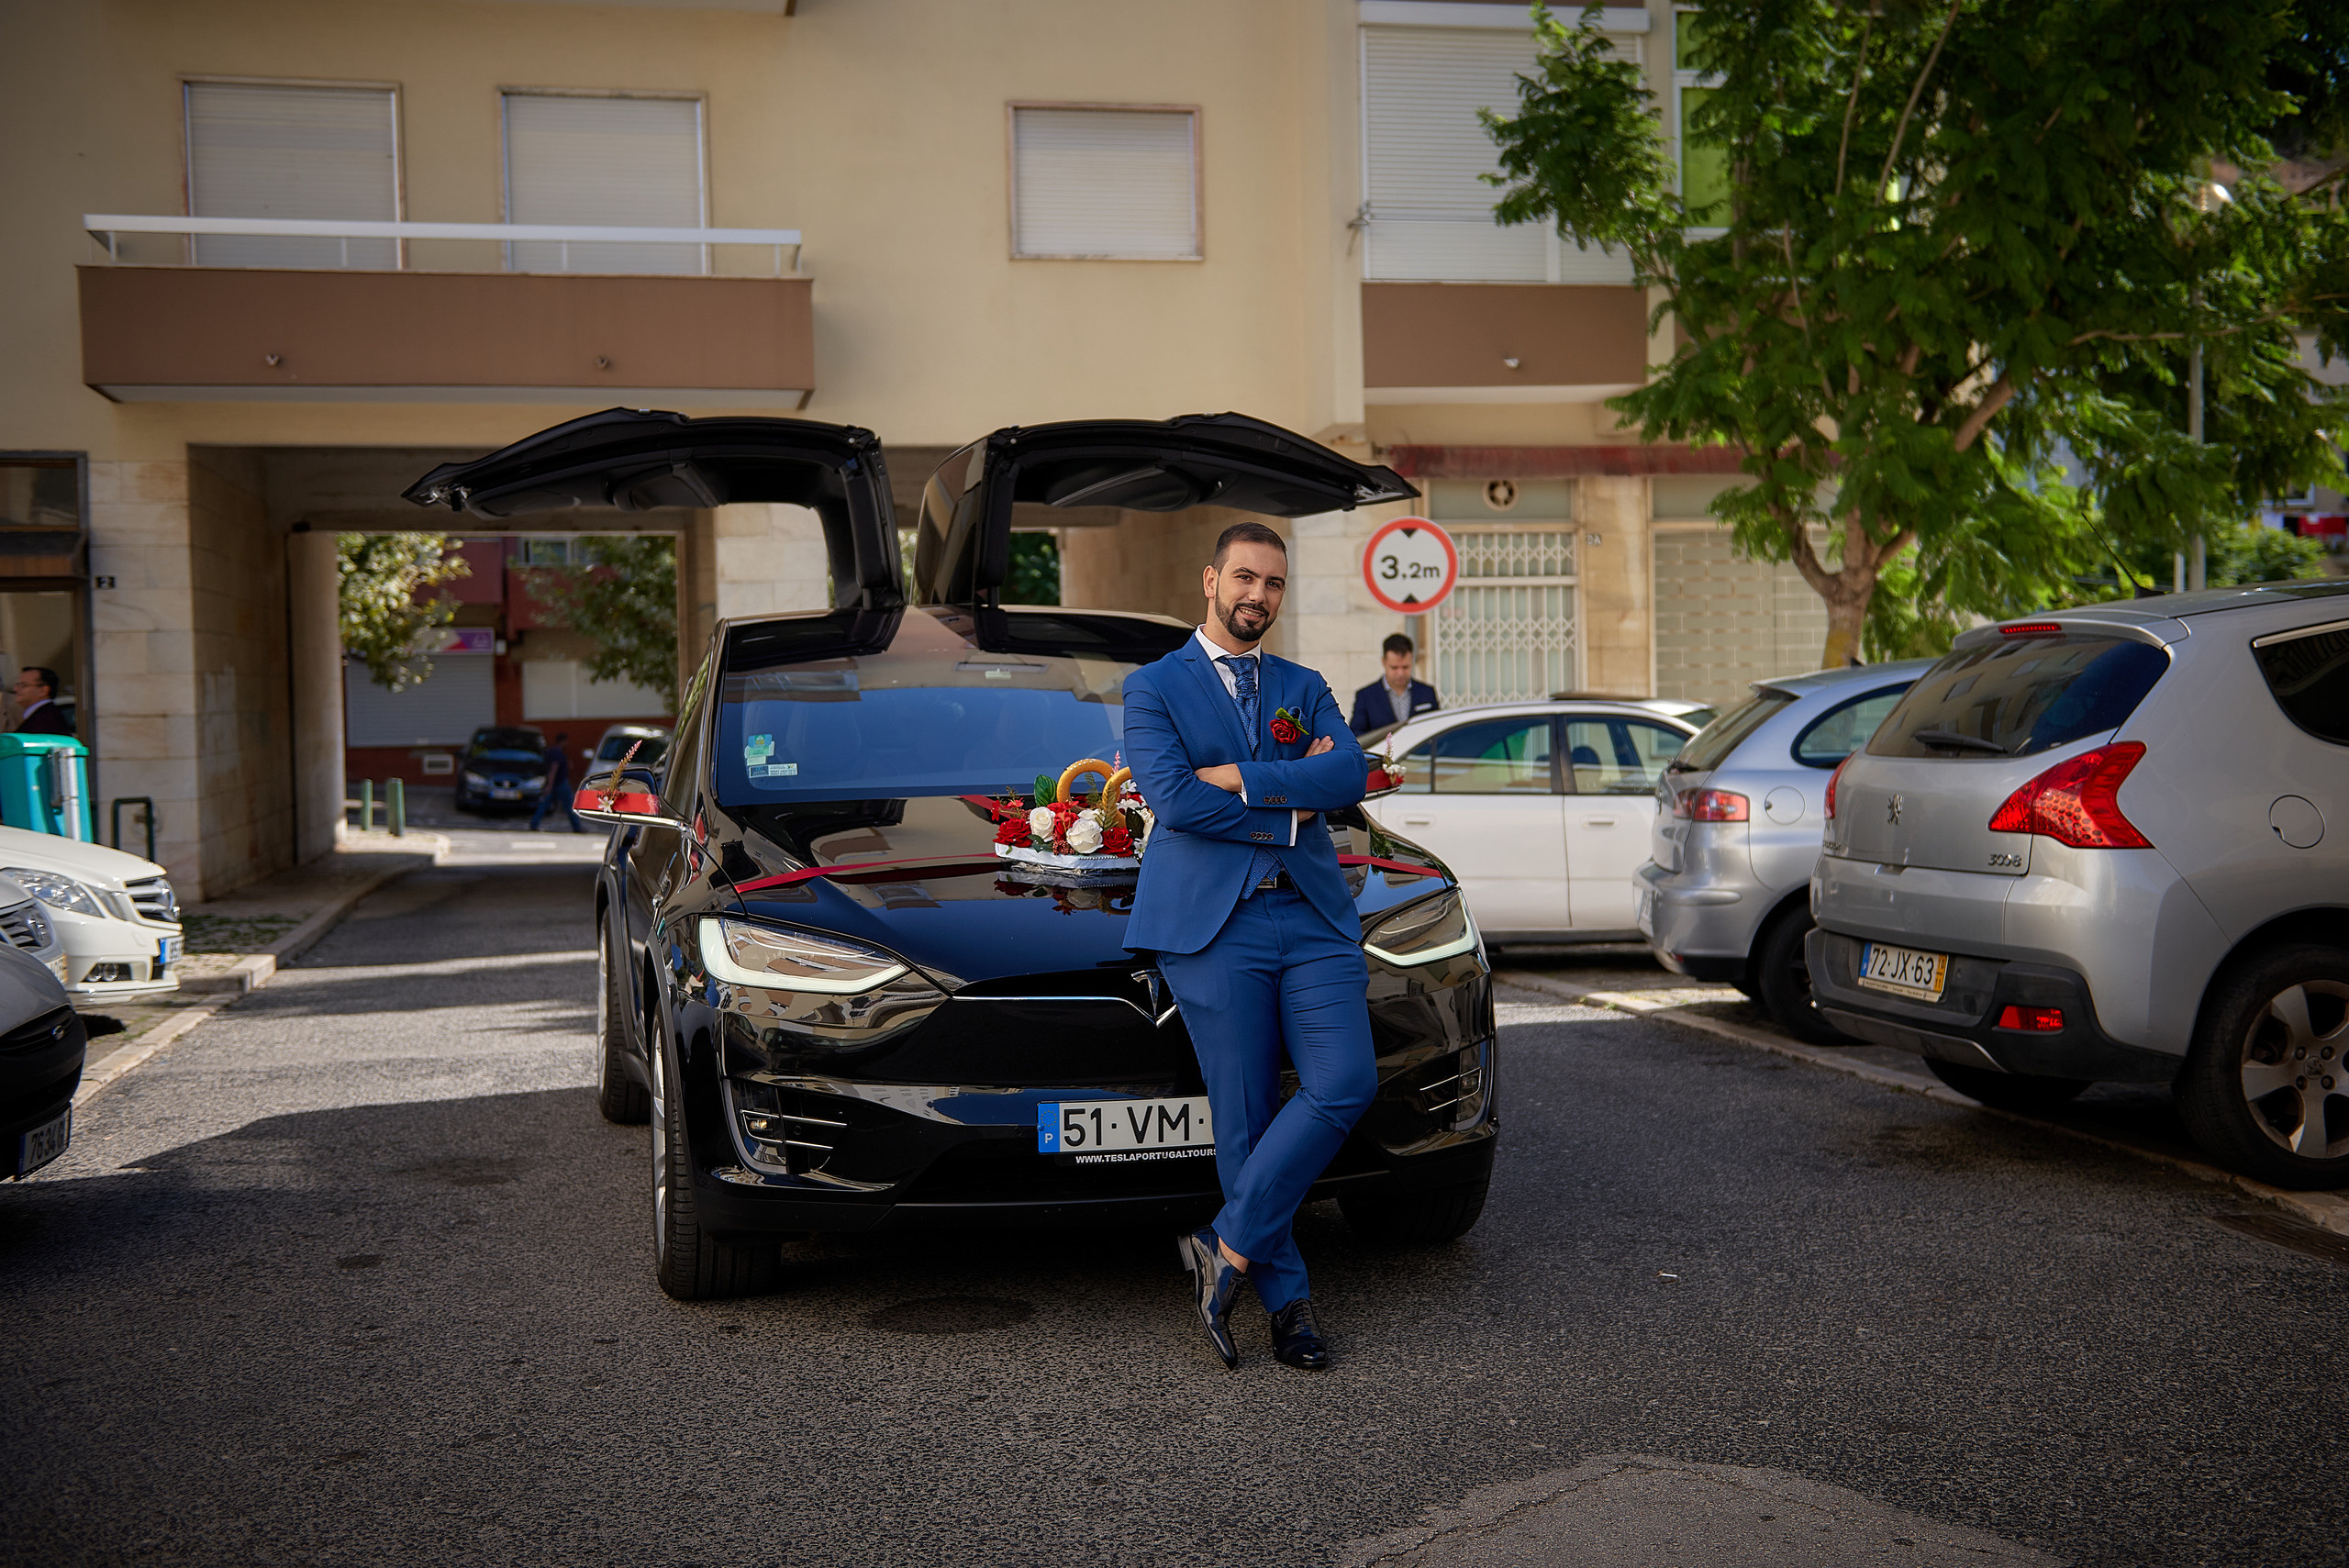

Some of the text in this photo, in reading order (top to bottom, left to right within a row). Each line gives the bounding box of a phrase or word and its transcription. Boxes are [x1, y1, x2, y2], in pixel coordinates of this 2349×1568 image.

[1380, 555, 1441, 580] 3.2m
[1987, 853, 2022, 867] 3008
[1044, 1133, 1053, 1144] P
